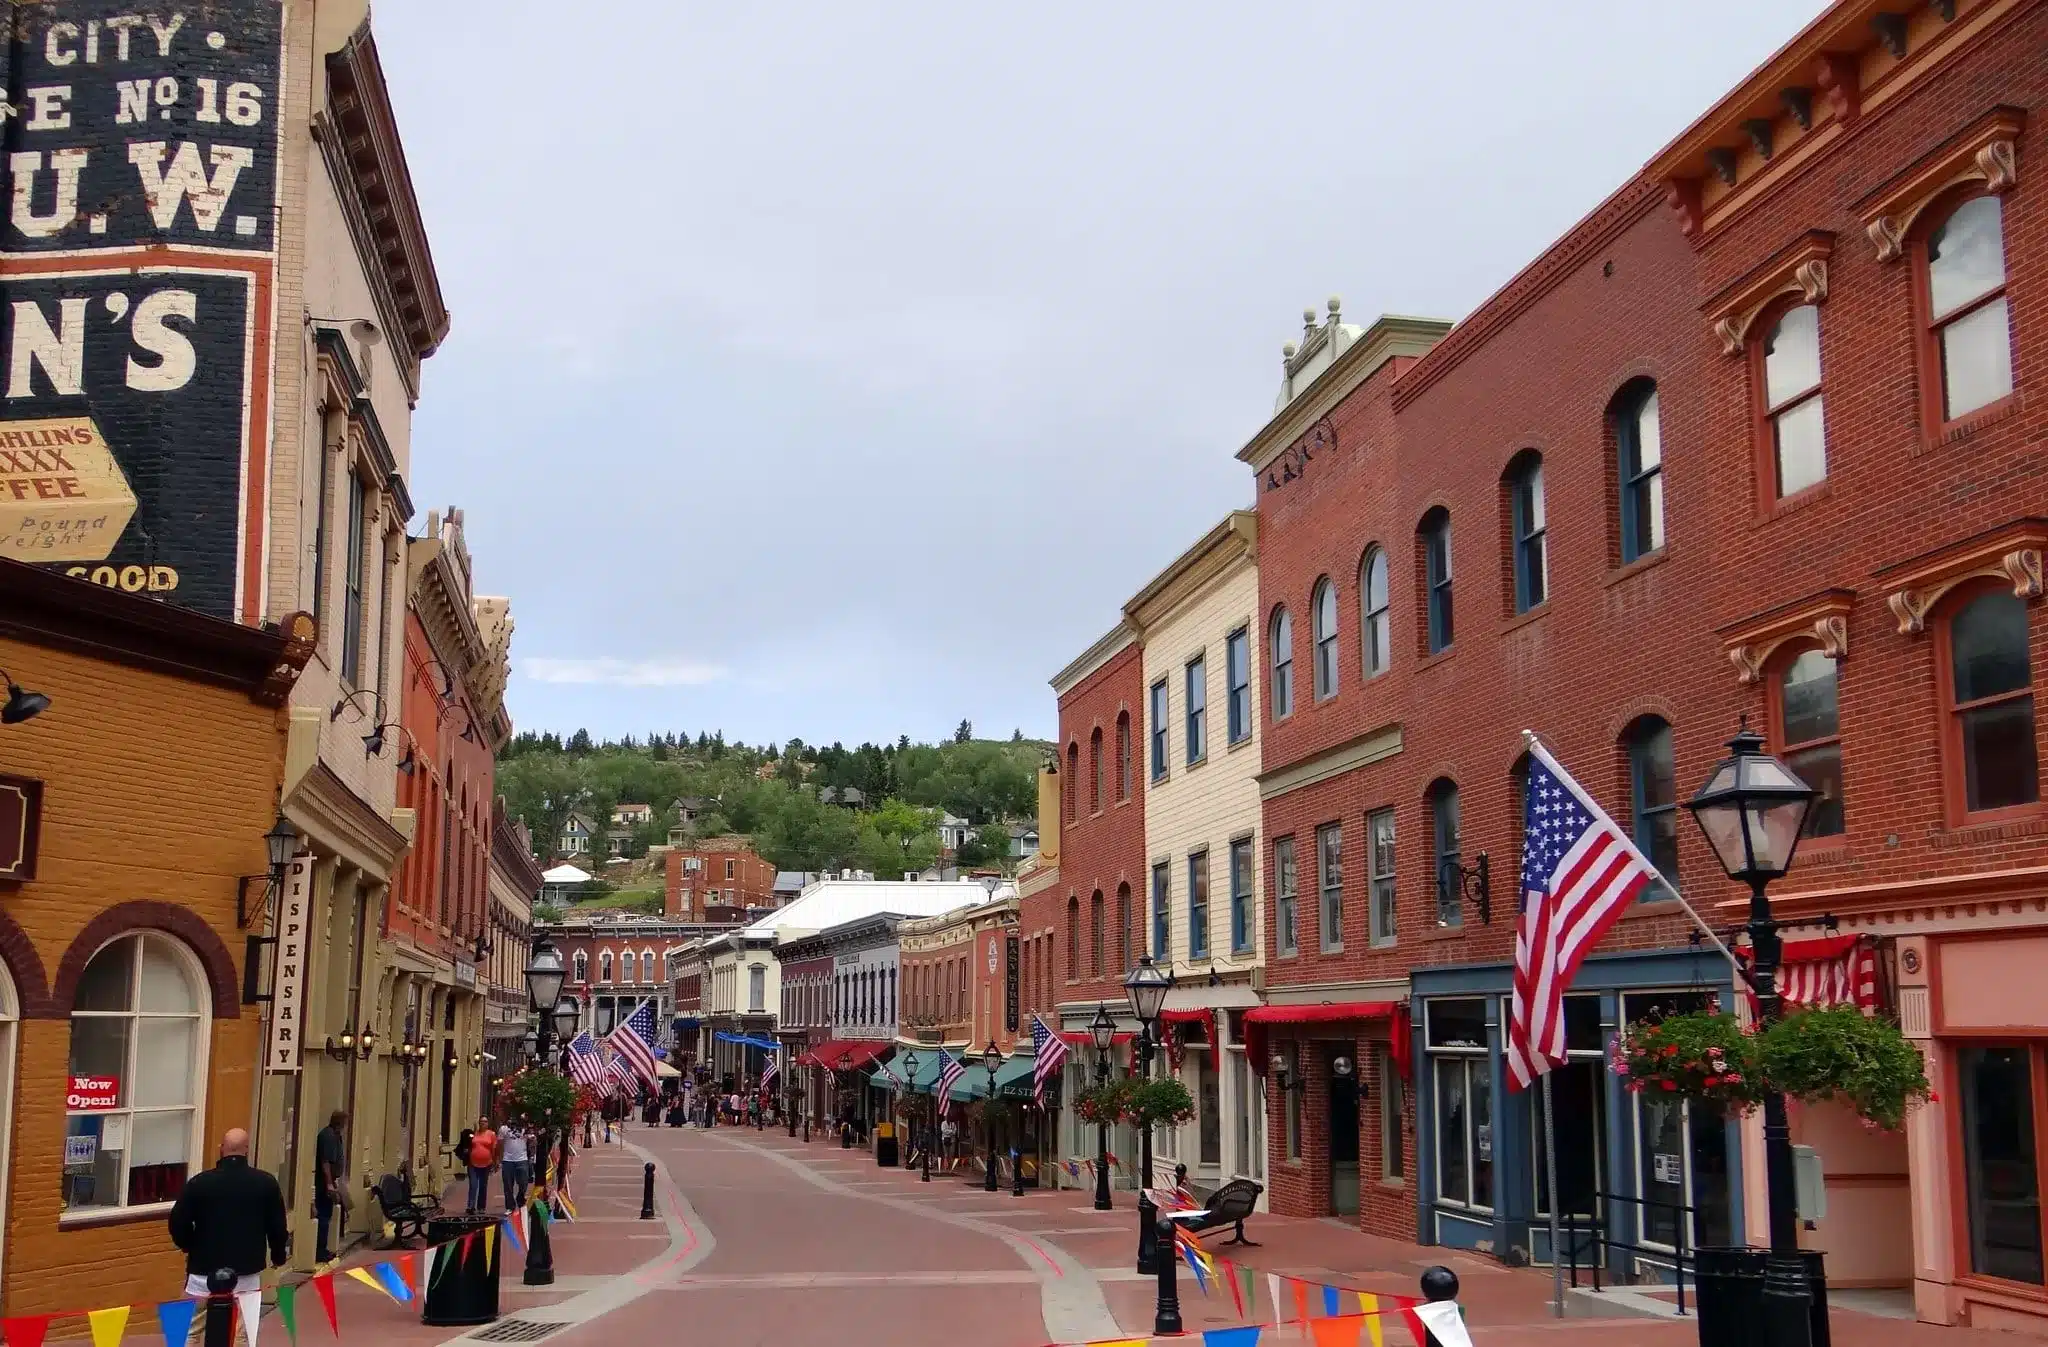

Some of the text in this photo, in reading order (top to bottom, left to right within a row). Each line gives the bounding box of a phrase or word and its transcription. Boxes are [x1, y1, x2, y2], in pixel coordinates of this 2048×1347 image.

[45, 14, 186, 66] CITY
[196, 78, 262, 126] 16
[0, 476, 87, 500] FEE
[278, 862, 304, 1063] DISPENSARY
[74, 1078, 112, 1090] Now
[1004, 1085, 1016, 1095] EZ
[67, 1094, 116, 1108] Open!
